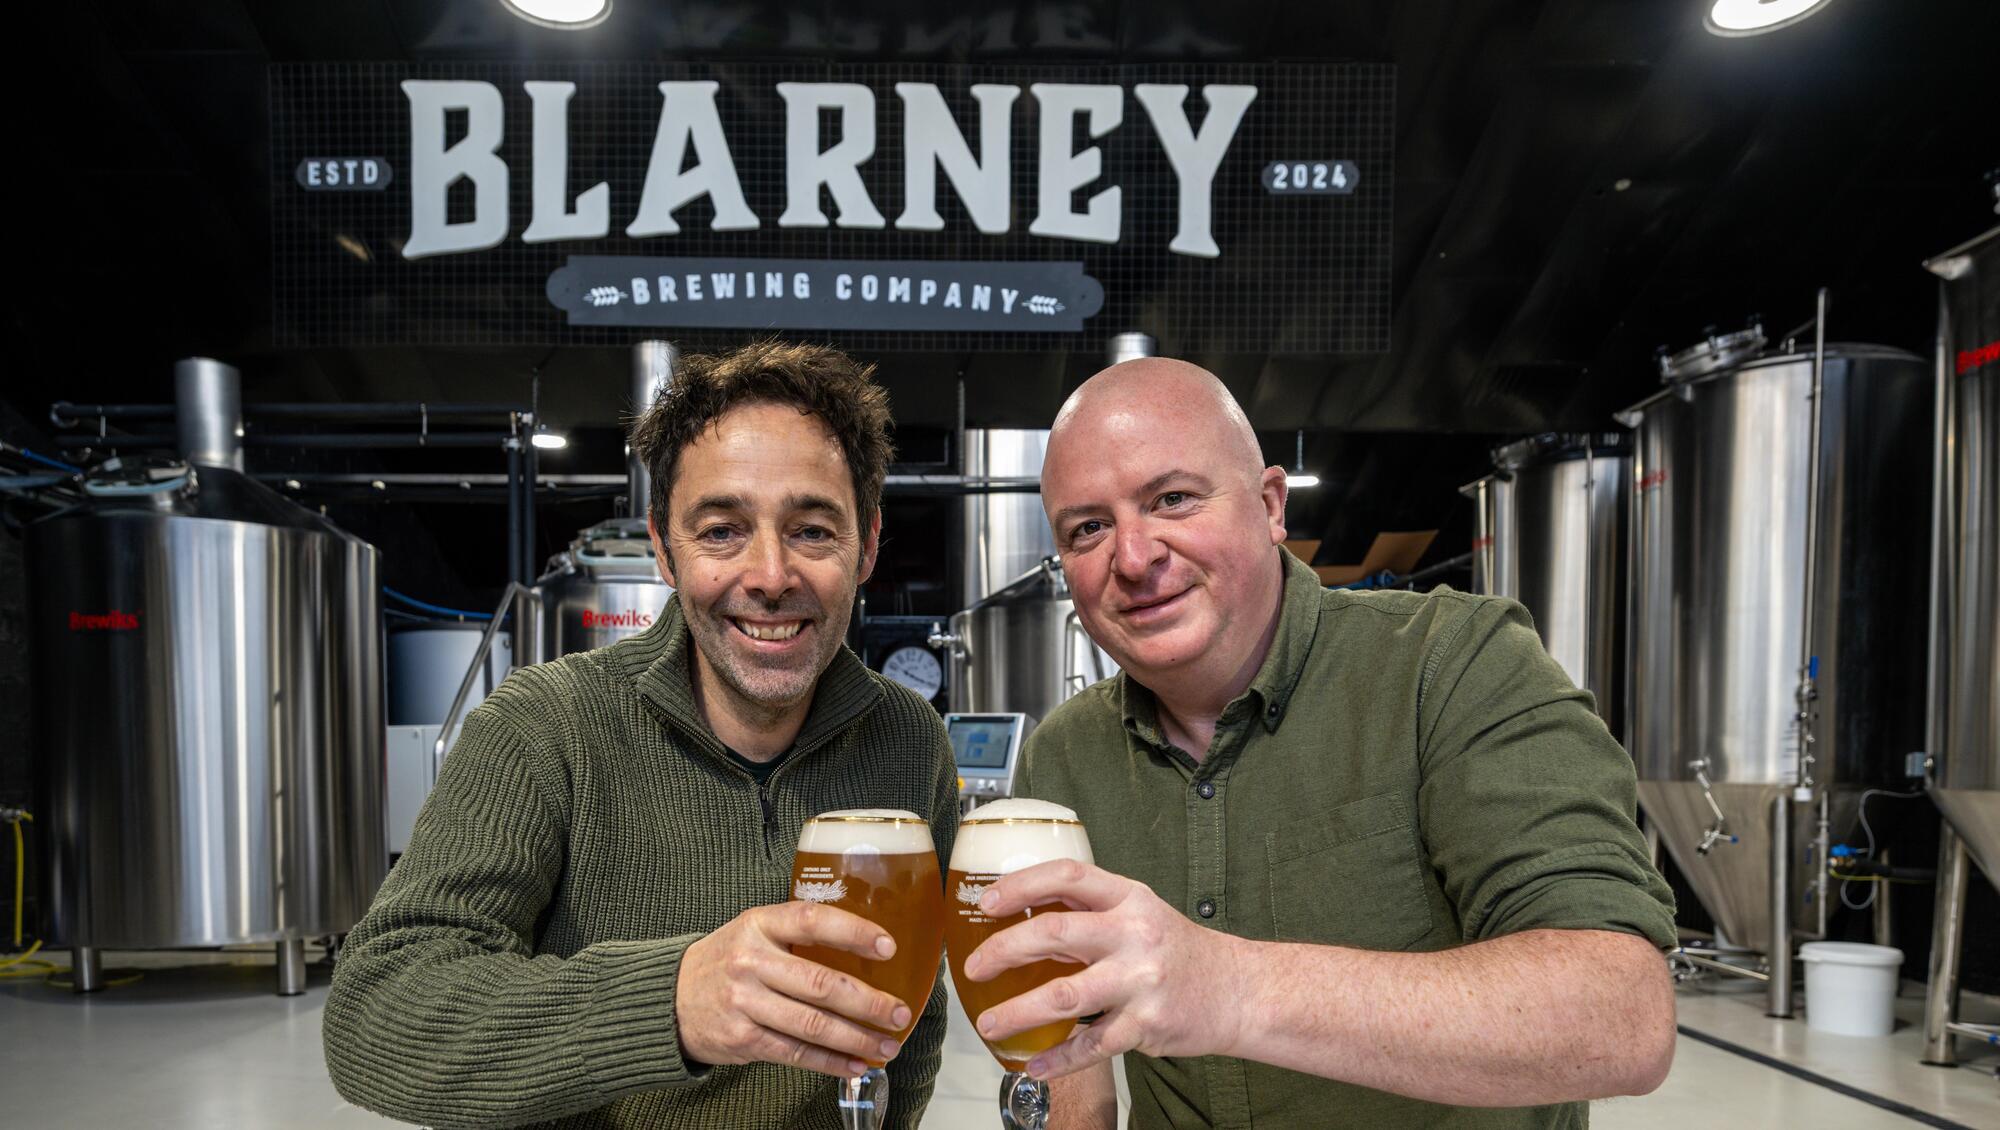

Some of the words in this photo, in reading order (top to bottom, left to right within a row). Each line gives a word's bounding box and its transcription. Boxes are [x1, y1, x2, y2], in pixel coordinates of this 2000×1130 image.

[307, 160, 379, 186] ESTD
[400, 79, 1258, 259] BLARNEY
[1272, 163, 1347, 190] 2024
[631, 272, 811, 305] BREWING
[836, 274, 1019, 314] COMPANY
[582, 608, 652, 629] Brewiks
